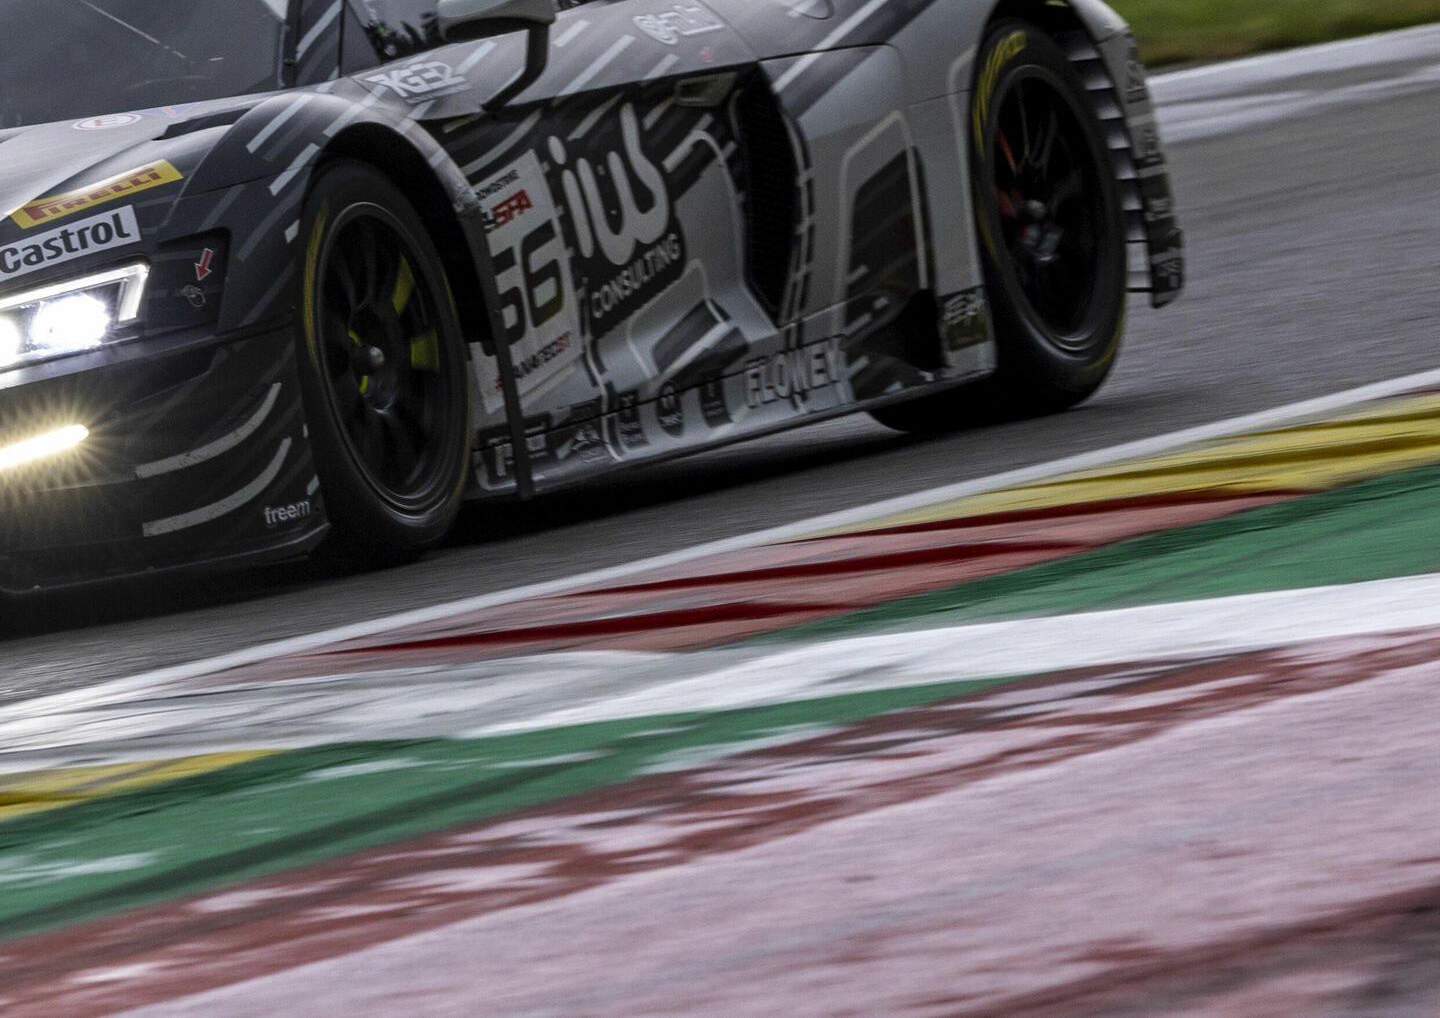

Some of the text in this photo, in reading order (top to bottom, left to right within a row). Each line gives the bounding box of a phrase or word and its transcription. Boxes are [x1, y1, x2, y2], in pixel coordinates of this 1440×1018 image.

[23, 167, 162, 220] PIRELLI
[590, 233, 680, 319] CONSULTING
[263, 500, 311, 525] freem
